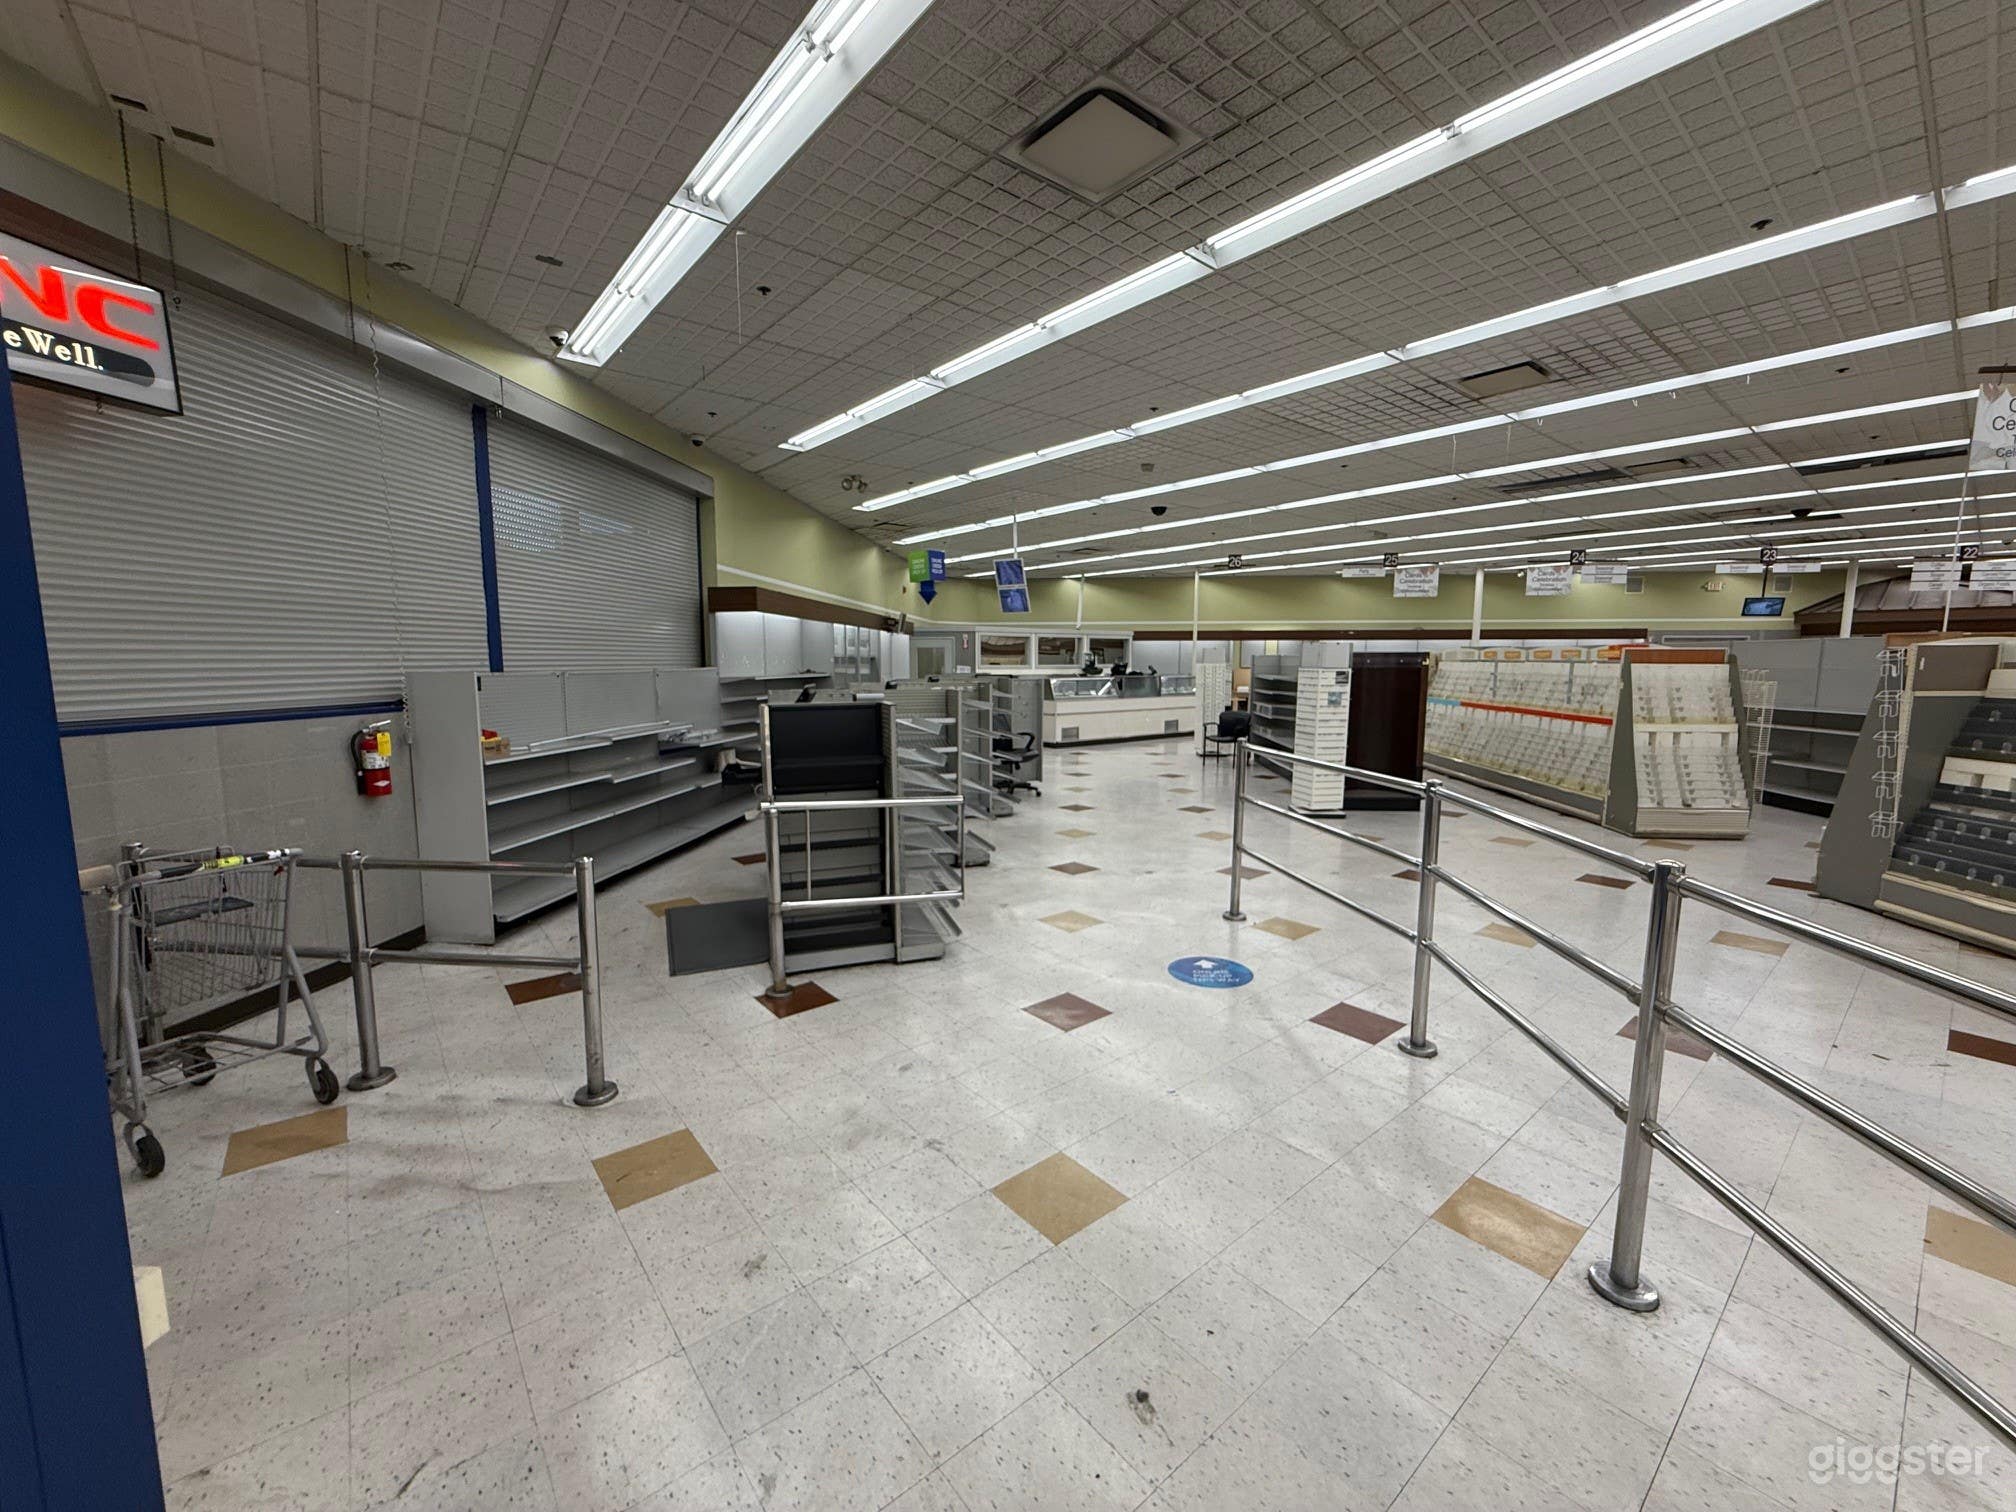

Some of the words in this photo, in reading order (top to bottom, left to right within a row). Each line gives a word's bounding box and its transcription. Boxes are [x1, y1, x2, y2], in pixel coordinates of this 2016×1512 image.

[1572, 551, 1585, 563] 24
[1762, 549, 1777, 561] 23
[1962, 547, 1978, 559] 22
[1229, 556, 1242, 567] 26
[1384, 554, 1398, 566] 25
